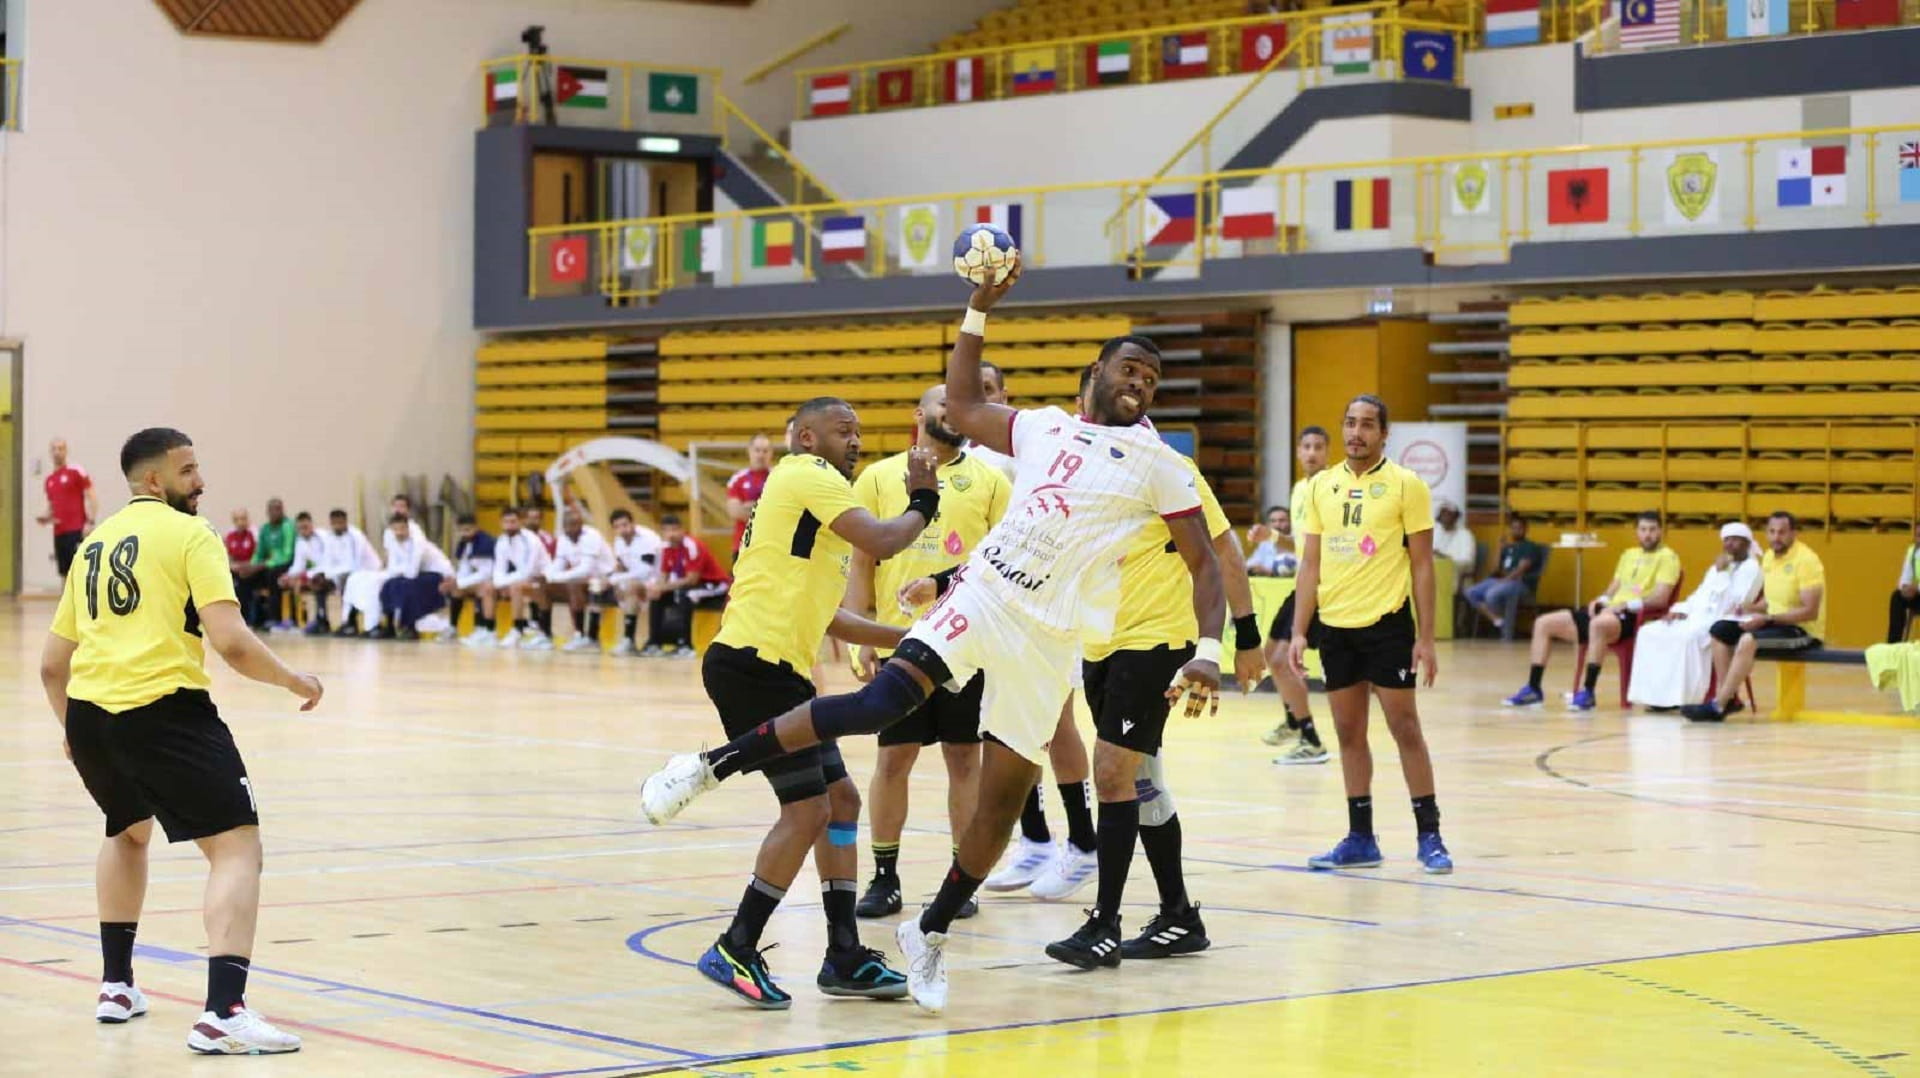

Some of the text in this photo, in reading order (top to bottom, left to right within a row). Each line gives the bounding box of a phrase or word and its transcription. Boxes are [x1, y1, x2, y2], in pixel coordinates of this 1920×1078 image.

[1047, 449, 1083, 483] 19
[1342, 502, 1362, 527] 14
[84, 535, 140, 620] 18
[933, 607, 968, 641] 19
[240, 777, 254, 812] 1
